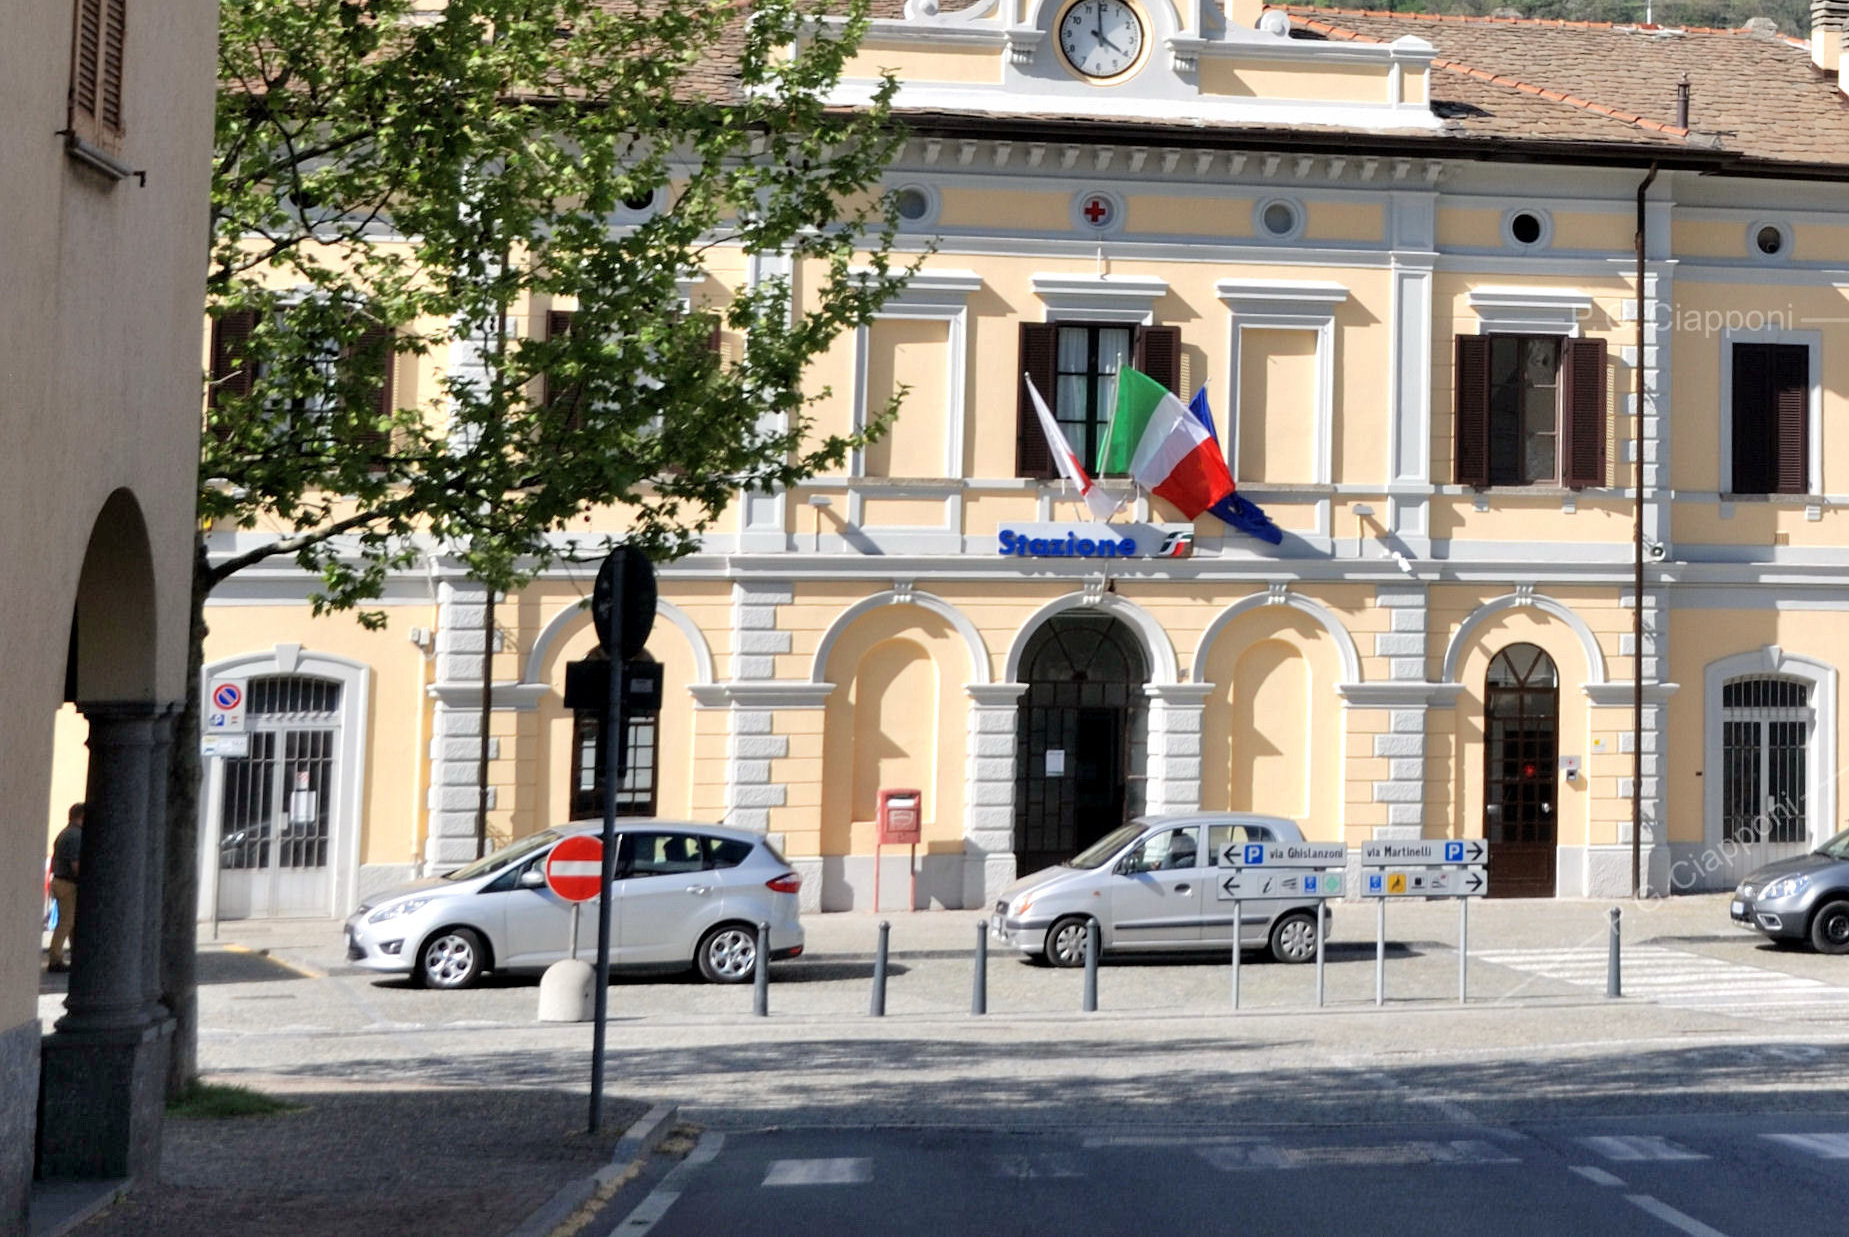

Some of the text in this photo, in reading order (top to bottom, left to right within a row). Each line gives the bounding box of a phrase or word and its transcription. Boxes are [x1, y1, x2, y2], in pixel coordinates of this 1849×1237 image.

[998, 529, 1137, 557] Stazione
[1269, 848, 1284, 859] via
[1287, 846, 1344, 859] Ghislanzoni
[1367, 846, 1381, 858] via
[1384, 845, 1432, 858] Martinelli
